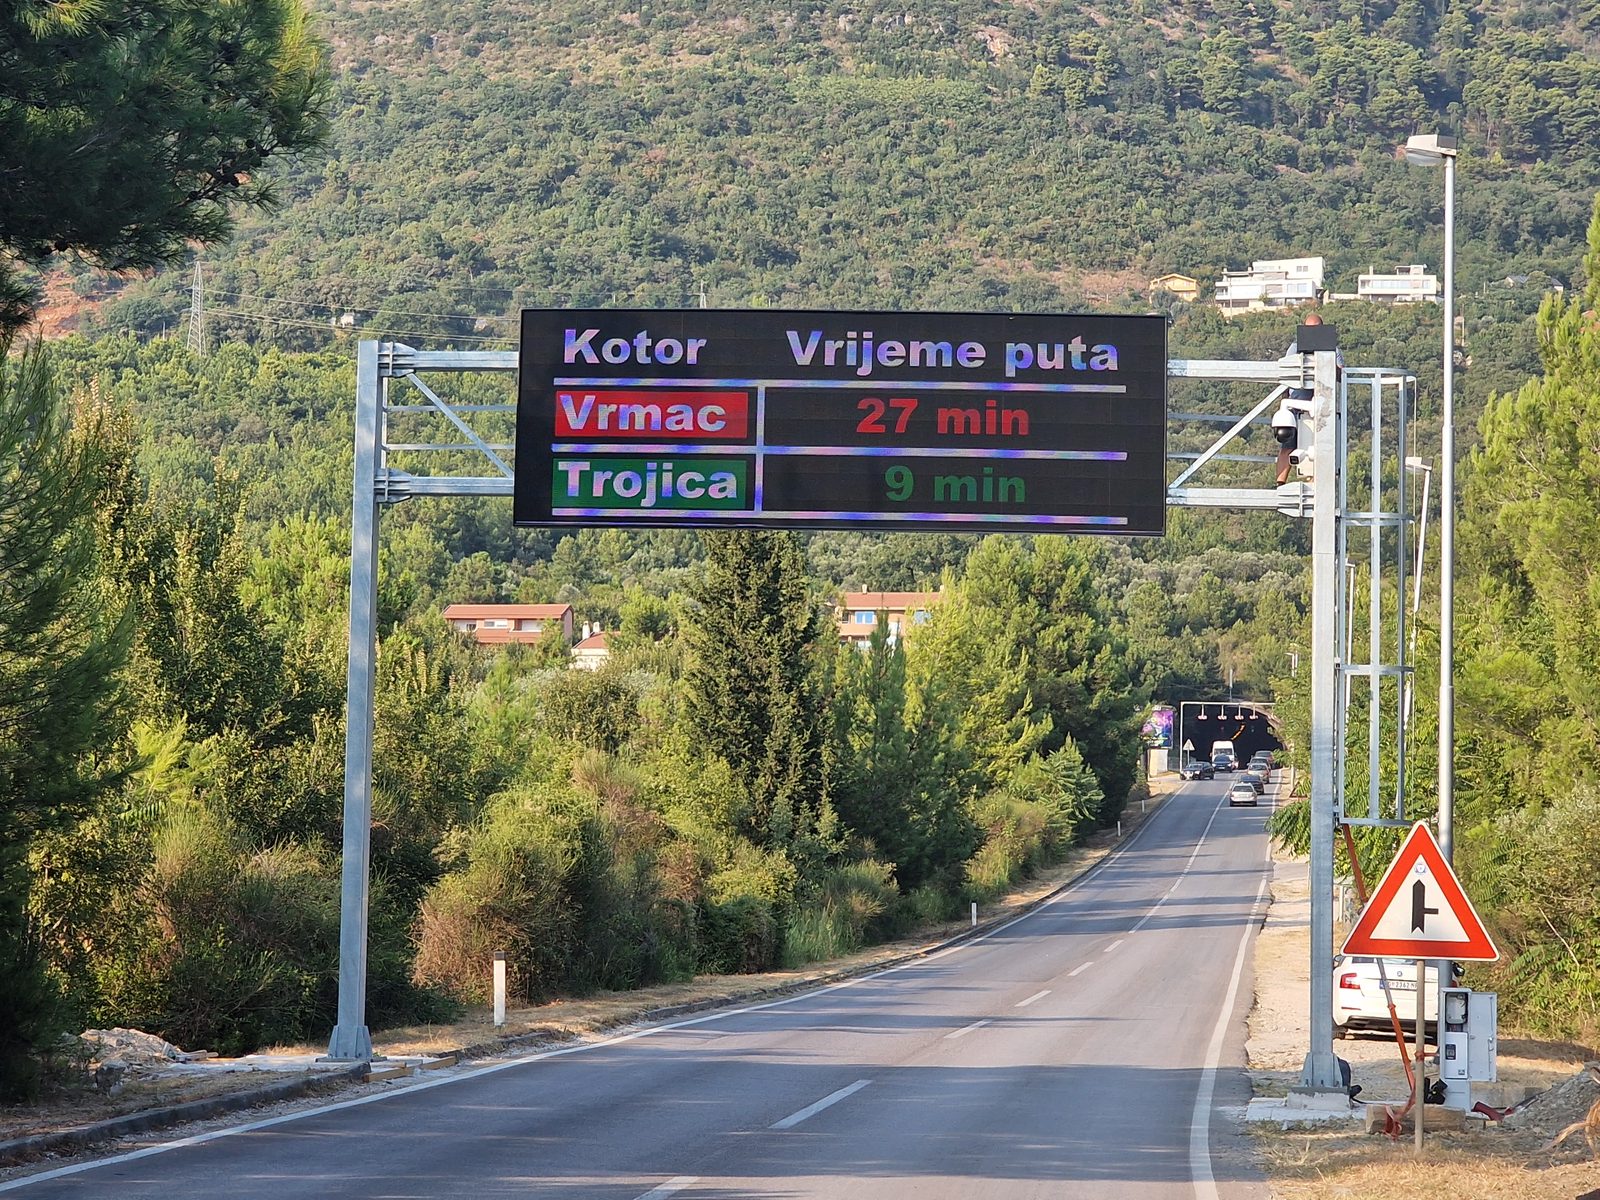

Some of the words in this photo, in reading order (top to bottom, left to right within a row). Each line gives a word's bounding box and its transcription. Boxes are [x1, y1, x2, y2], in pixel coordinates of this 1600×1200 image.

[564, 328, 708, 366] Kotor
[786, 329, 987, 377] Vrijeme
[1005, 335, 1119, 379] puta
[559, 394, 727, 433] Vrmac
[856, 398, 919, 434] 27
[937, 399, 1030, 436] min
[558, 461, 738, 508] Trojica
[884, 465, 915, 502] 9
[934, 467, 1026, 503] min
